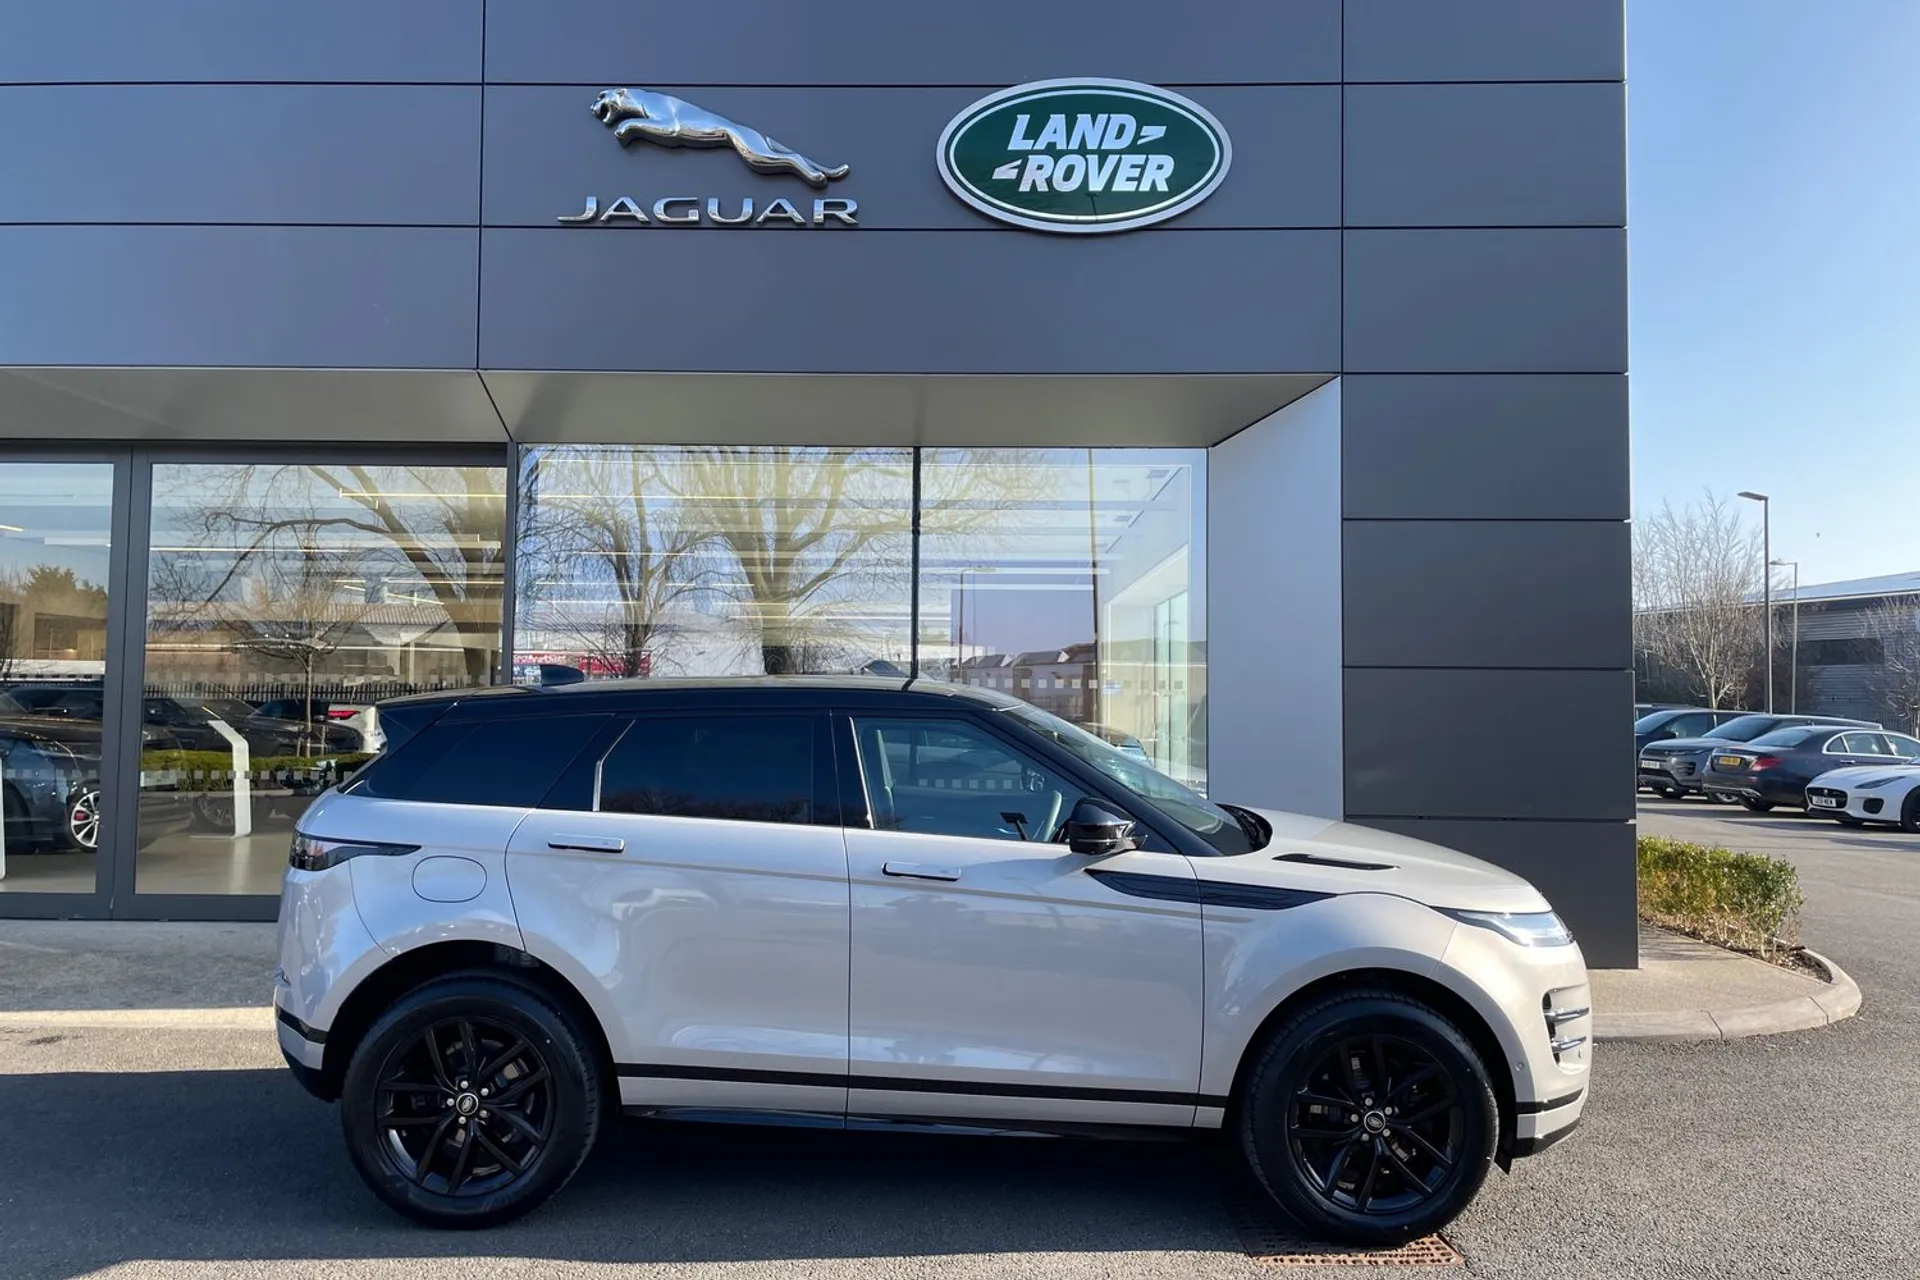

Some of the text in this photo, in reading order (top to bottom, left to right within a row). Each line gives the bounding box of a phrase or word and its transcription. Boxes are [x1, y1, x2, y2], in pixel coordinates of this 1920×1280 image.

[1007, 113, 1137, 150] LAND
[1018, 154, 1175, 192] ROVER
[557, 196, 859, 224] JAGUAR
